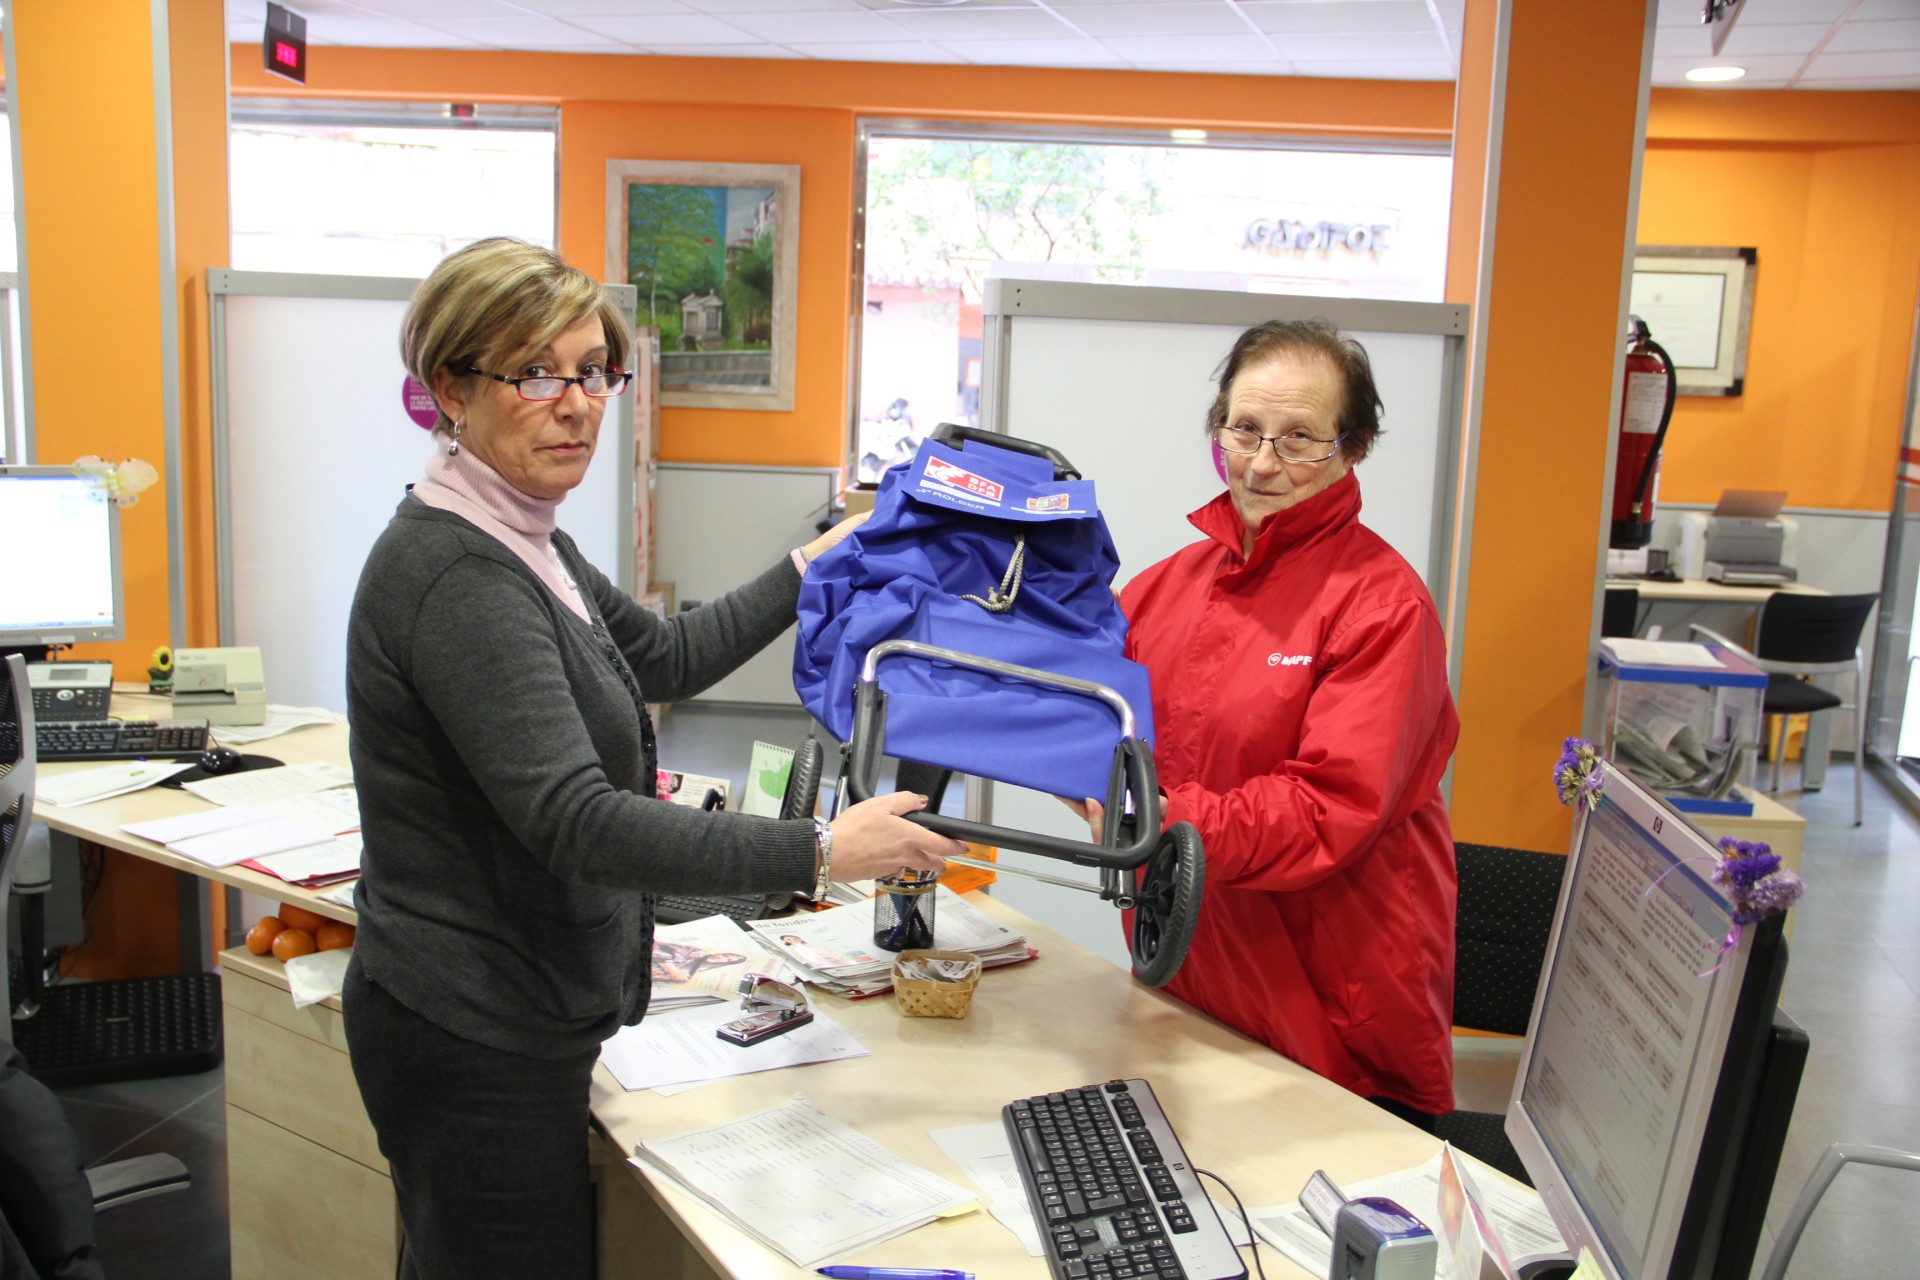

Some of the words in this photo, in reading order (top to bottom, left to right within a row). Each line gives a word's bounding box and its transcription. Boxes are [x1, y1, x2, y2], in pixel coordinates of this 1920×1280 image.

[968, 483, 995, 498] DFB
[969, 476, 996, 493] BFA
[931, 491, 985, 510] ROLSER
